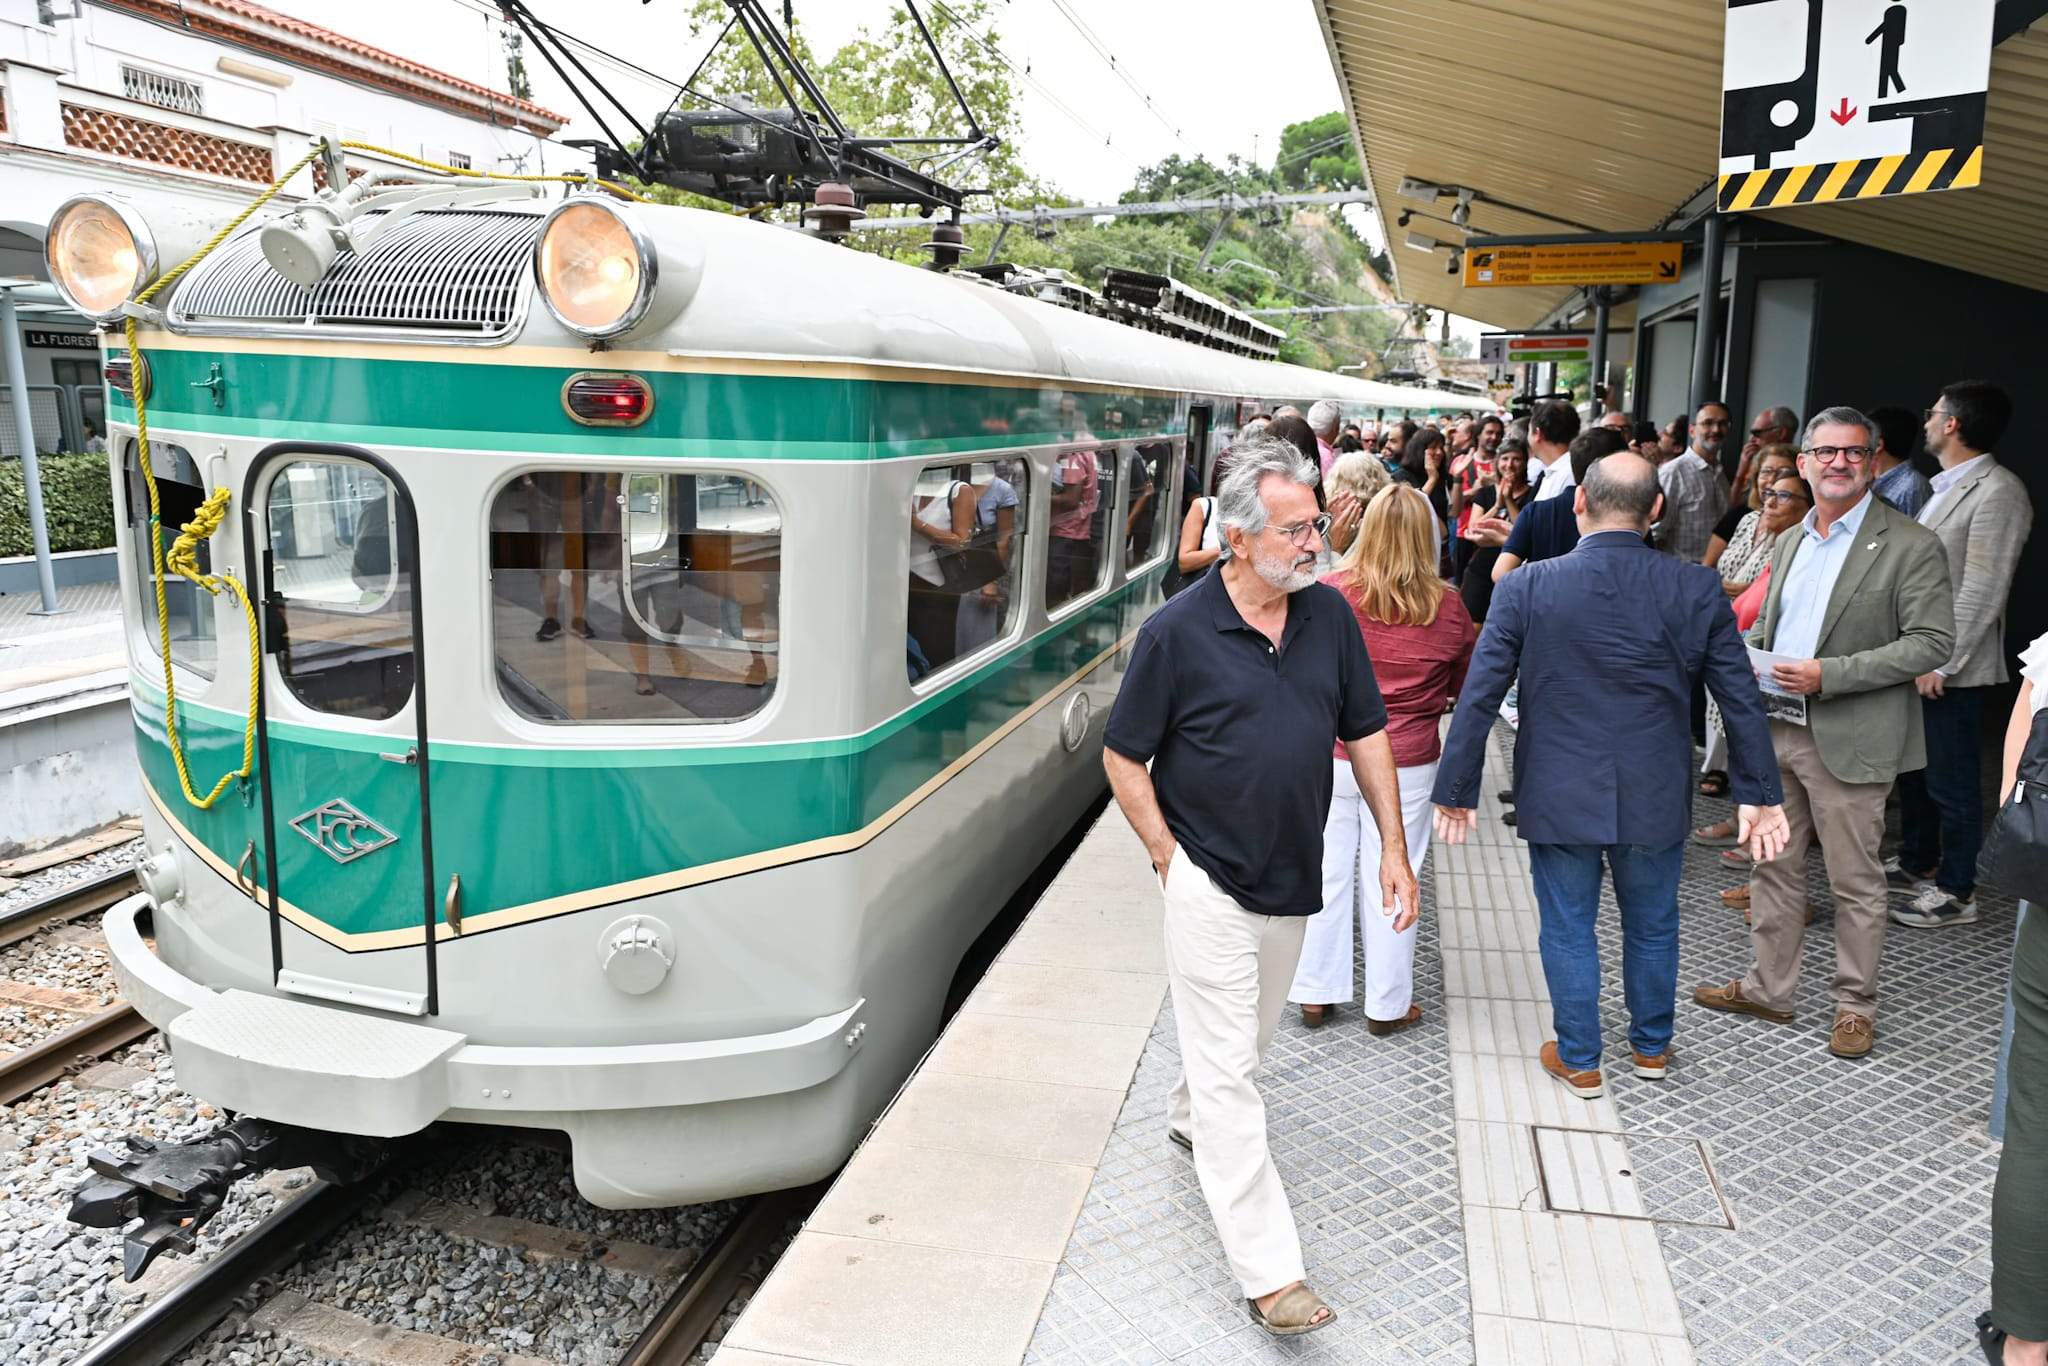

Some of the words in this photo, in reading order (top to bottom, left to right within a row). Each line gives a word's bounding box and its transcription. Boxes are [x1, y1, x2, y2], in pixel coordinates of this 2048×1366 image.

[32, 334, 47, 344] LA
[49, 335, 97, 347] FLOREST
[1494, 347, 1500, 359] 1
